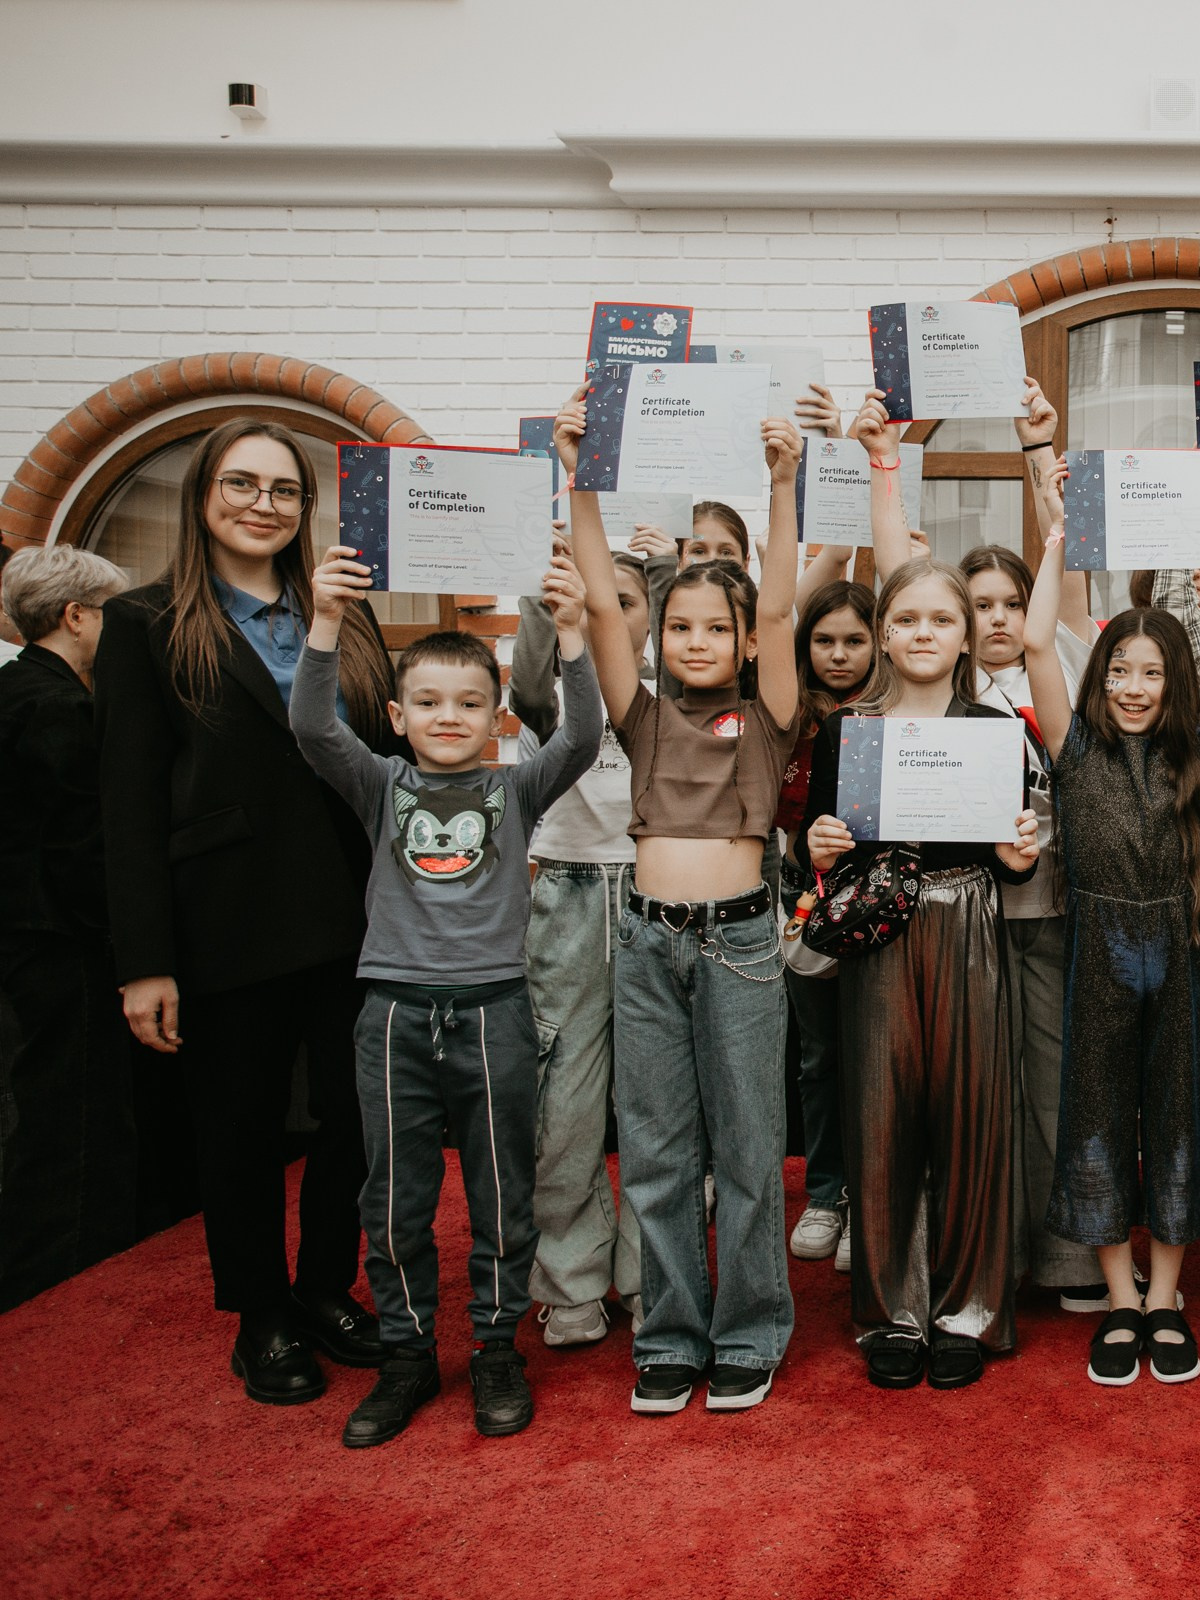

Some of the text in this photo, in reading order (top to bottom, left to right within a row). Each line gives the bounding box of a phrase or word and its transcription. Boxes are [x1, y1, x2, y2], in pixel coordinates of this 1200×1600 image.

[608, 336, 672, 347] БЛАГОДАРСТВЕННОЕ
[922, 333, 966, 341] Certificate
[607, 343, 668, 359] ПИСЬМО
[933, 343, 980, 351] Completion
[642, 397, 691, 406] Certificate
[641, 408, 705, 417] of Completion
[820, 467, 860, 475] Certificate
[408, 488, 467, 501] Certificate
[1131, 492, 1182, 500] Completion
[408, 501, 486, 514] of Completion
[899, 749, 948, 757] Certificate
[600, 761, 618, 769] Love
[910, 759, 962, 768] Completion
